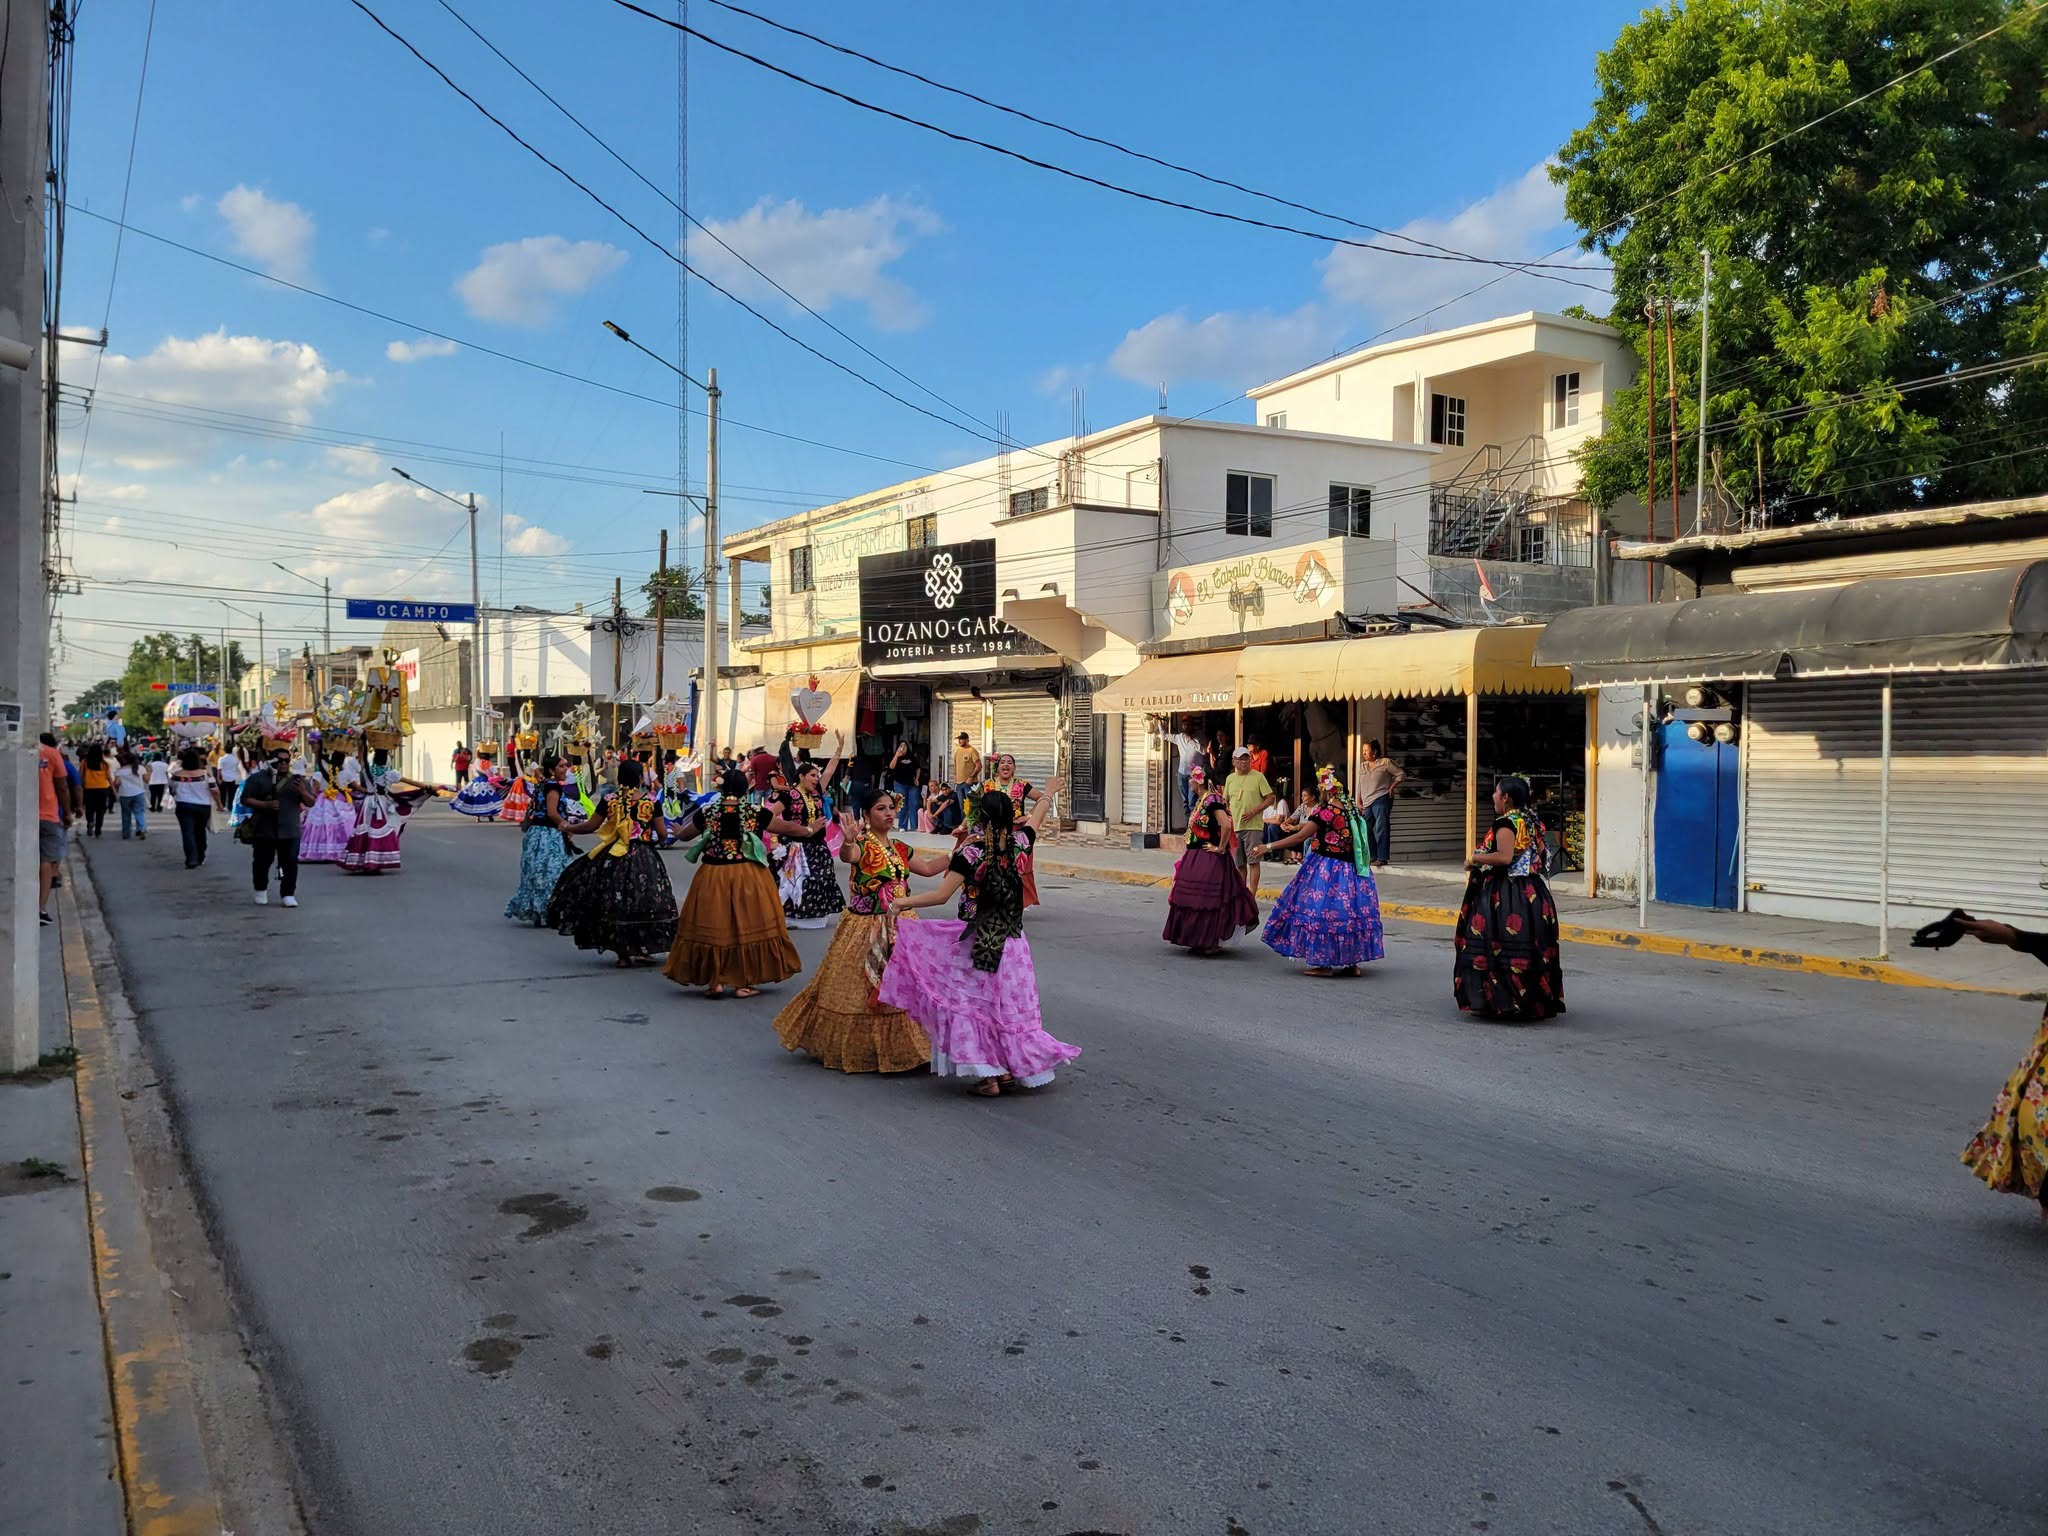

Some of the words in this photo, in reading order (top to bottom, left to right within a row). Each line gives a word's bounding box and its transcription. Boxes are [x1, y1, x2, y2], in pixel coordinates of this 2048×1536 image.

[1197, 579, 1214, 602] El
[1212, 558, 1253, 589] Caballo
[1254, 556, 1294, 589] Blanco
[376, 604, 449, 619] OCAMPO
[886, 644, 935, 658] JOYERÍA
[950, 643, 976, 655] EST.
[982, 640, 1012, 652] 1984
[1124, 697, 1135, 707] EL
[1140, 694, 1183, 706] CABALLO
